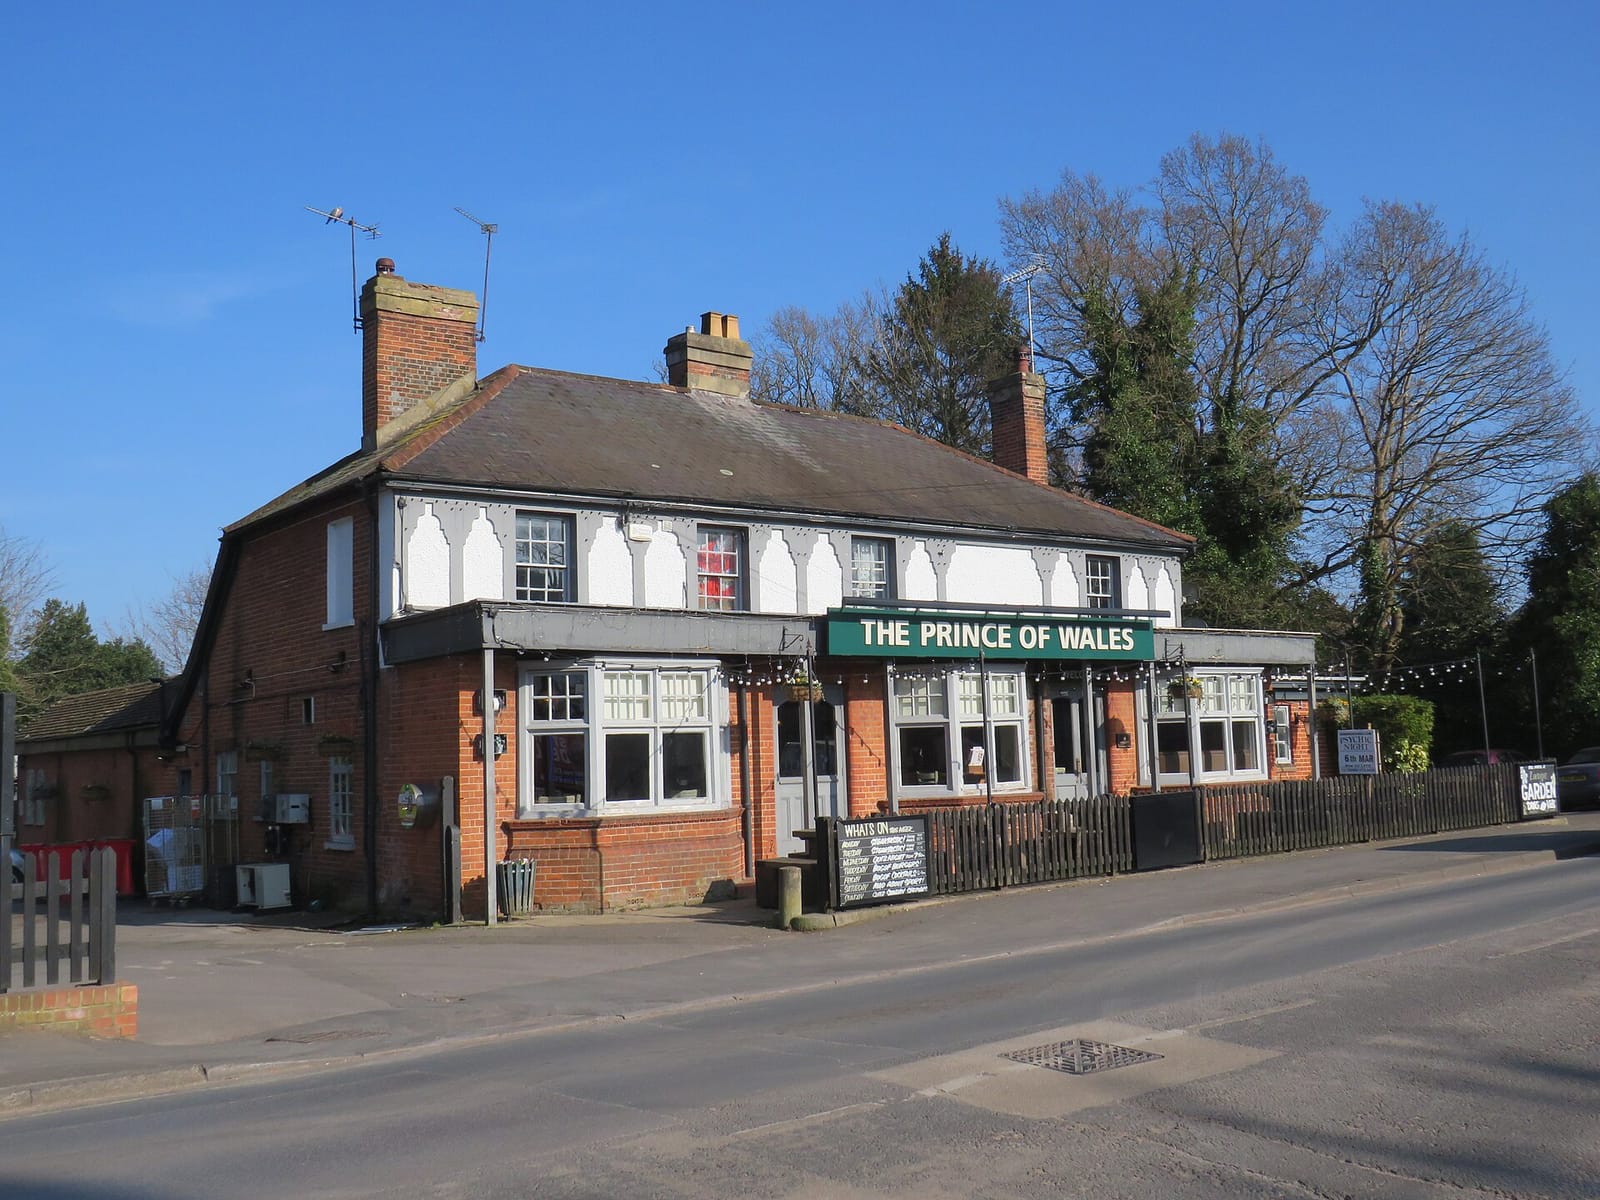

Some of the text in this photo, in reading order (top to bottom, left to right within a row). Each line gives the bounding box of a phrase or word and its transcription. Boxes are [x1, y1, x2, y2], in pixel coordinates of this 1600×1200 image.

[860, 618, 1135, 651] THE PRINCE OF WALES
[1340, 736, 1372, 744] PSYCHIC
[1521, 782, 1556, 800] GARDEN
[845, 823, 875, 837] WHATS
[877, 821, 889, 835] ON
